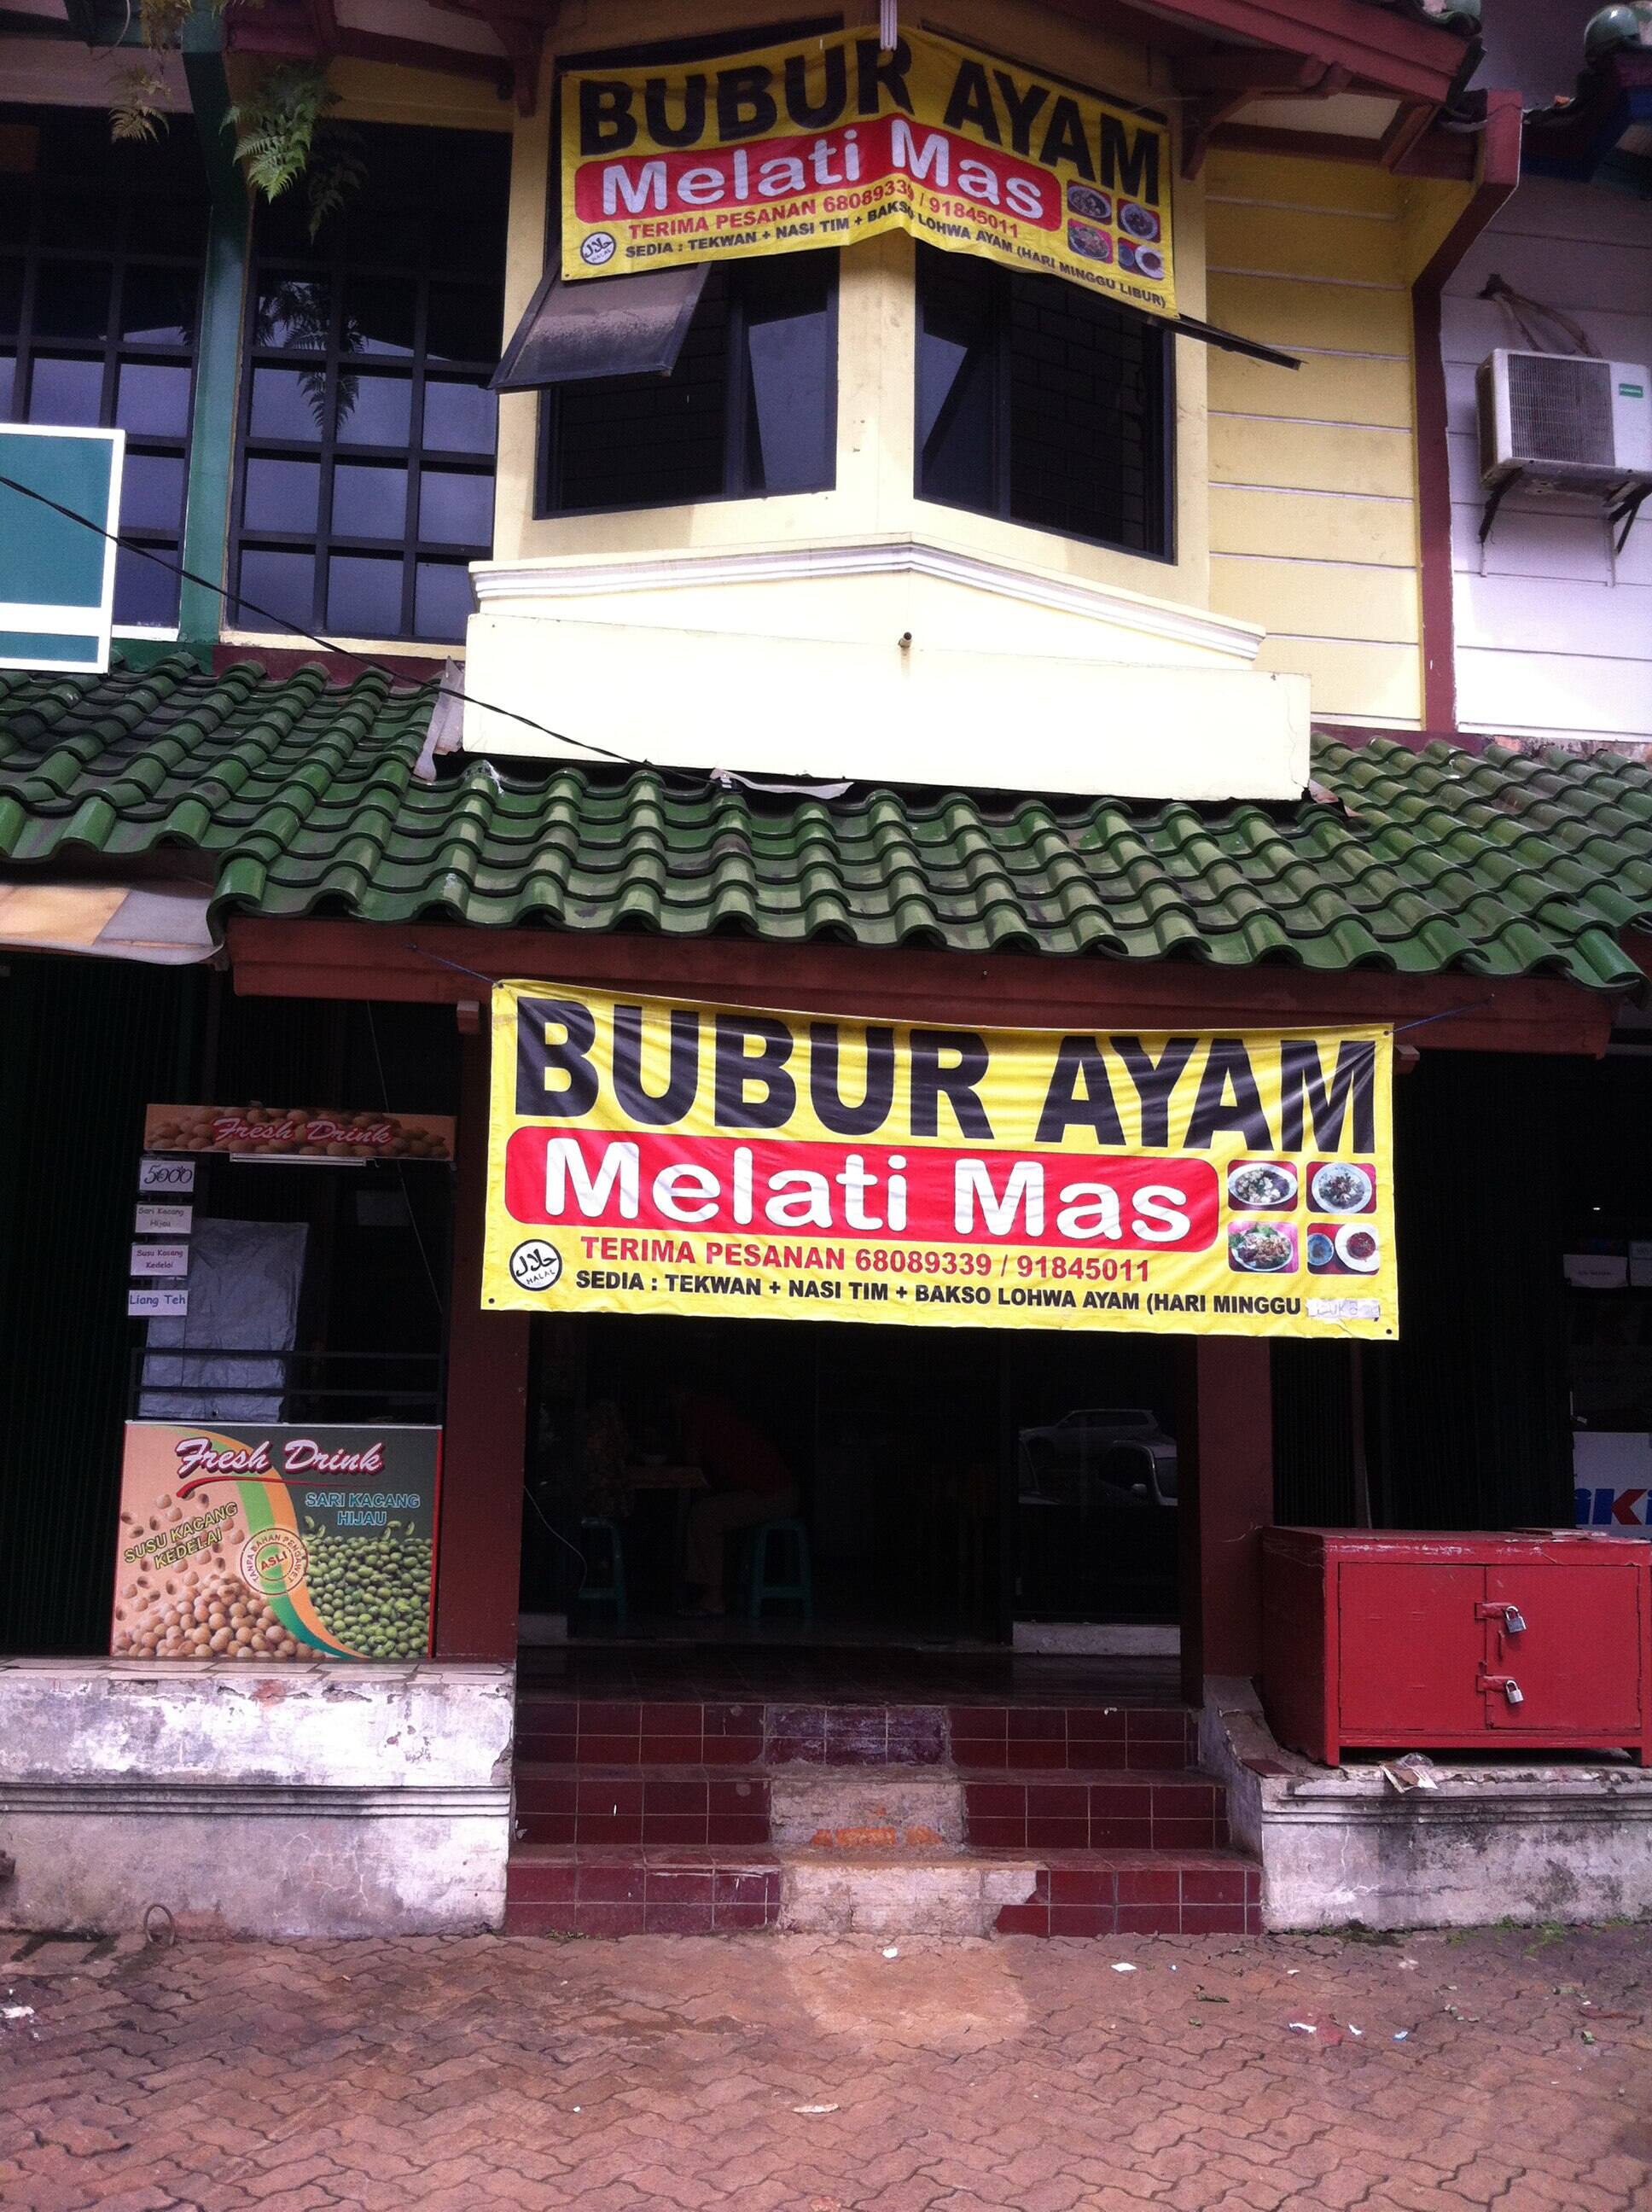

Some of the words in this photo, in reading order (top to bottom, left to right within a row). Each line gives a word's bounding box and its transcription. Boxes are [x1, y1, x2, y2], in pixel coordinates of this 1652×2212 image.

[580, 37, 915, 157] BUBUR
[943, 57, 1160, 207] AYAM
[602, 129, 860, 215] Melati
[891, 119, 1044, 219] Mas
[629, 215, 709, 239] TERIMA
[716, 199, 816, 230] PESANAN
[823, 178, 915, 213] 68089339
[928, 197, 1019, 239] 91845011
[625, 242, 673, 258] SEDIA
[688, 231, 757, 252] TEKWAN
[776, 223, 814, 239] NASI
[820, 218, 849, 233] TIM
[868, 200, 914, 222] BAKSO
[918, 212, 971, 241] LOHWA
[976, 229, 1013, 253] AYAM
[1016, 245, 1056, 268] (HARI
[1060, 261, 1116, 290] MINGGU
[1120, 279, 1166, 309] LIBUR)
[515, 996, 994, 1139] BUBUR
[1035, 1034, 1376, 1155] AYAM
[212, 1117, 294, 1140] Fresh
[306, 1120, 393, 1144] Drink
[545, 1138, 908, 1232] Melati
[953, 1158, 1191, 1243] Mas
[580, 1236, 695, 1264] TERIMA
[707, 1243, 844, 1270] PESANAN
[855, 1249, 992, 1277] 68089339
[1017, 1256, 1149, 1282] 91845011
[130, 1295, 160, 1307] Liang
[164, 1294, 186, 1306] Teh
[576, 1270, 644, 1290] SEDIA
[665, 1274, 761, 1295] TEKWAN
[789, 1279, 841, 1299] NASI
[849, 1282, 888, 1301] TIM
[915, 1284, 992, 1305] BAKSO
[998, 1288, 1076, 1308] LOHWA
[1083, 1291, 1139, 1311] AYAM
[1148, 1294, 1205, 1315] (HARI
[1213, 1295, 1300, 1316] MINGGU
[177, 1437, 273, 1478] Fresh
[283, 1437, 386, 1476] Drink
[305, 1493, 345, 1508] SARI
[348, 1493, 421, 1509] KACANG
[336, 1511, 387, 1526] HIJAU
[124, 1535, 169, 1564] SUSU
[170, 1502, 238, 1542] KACANG
[154, 1528, 222, 1570] KEDELAI
[260, 1551, 288, 1571] ASLI
